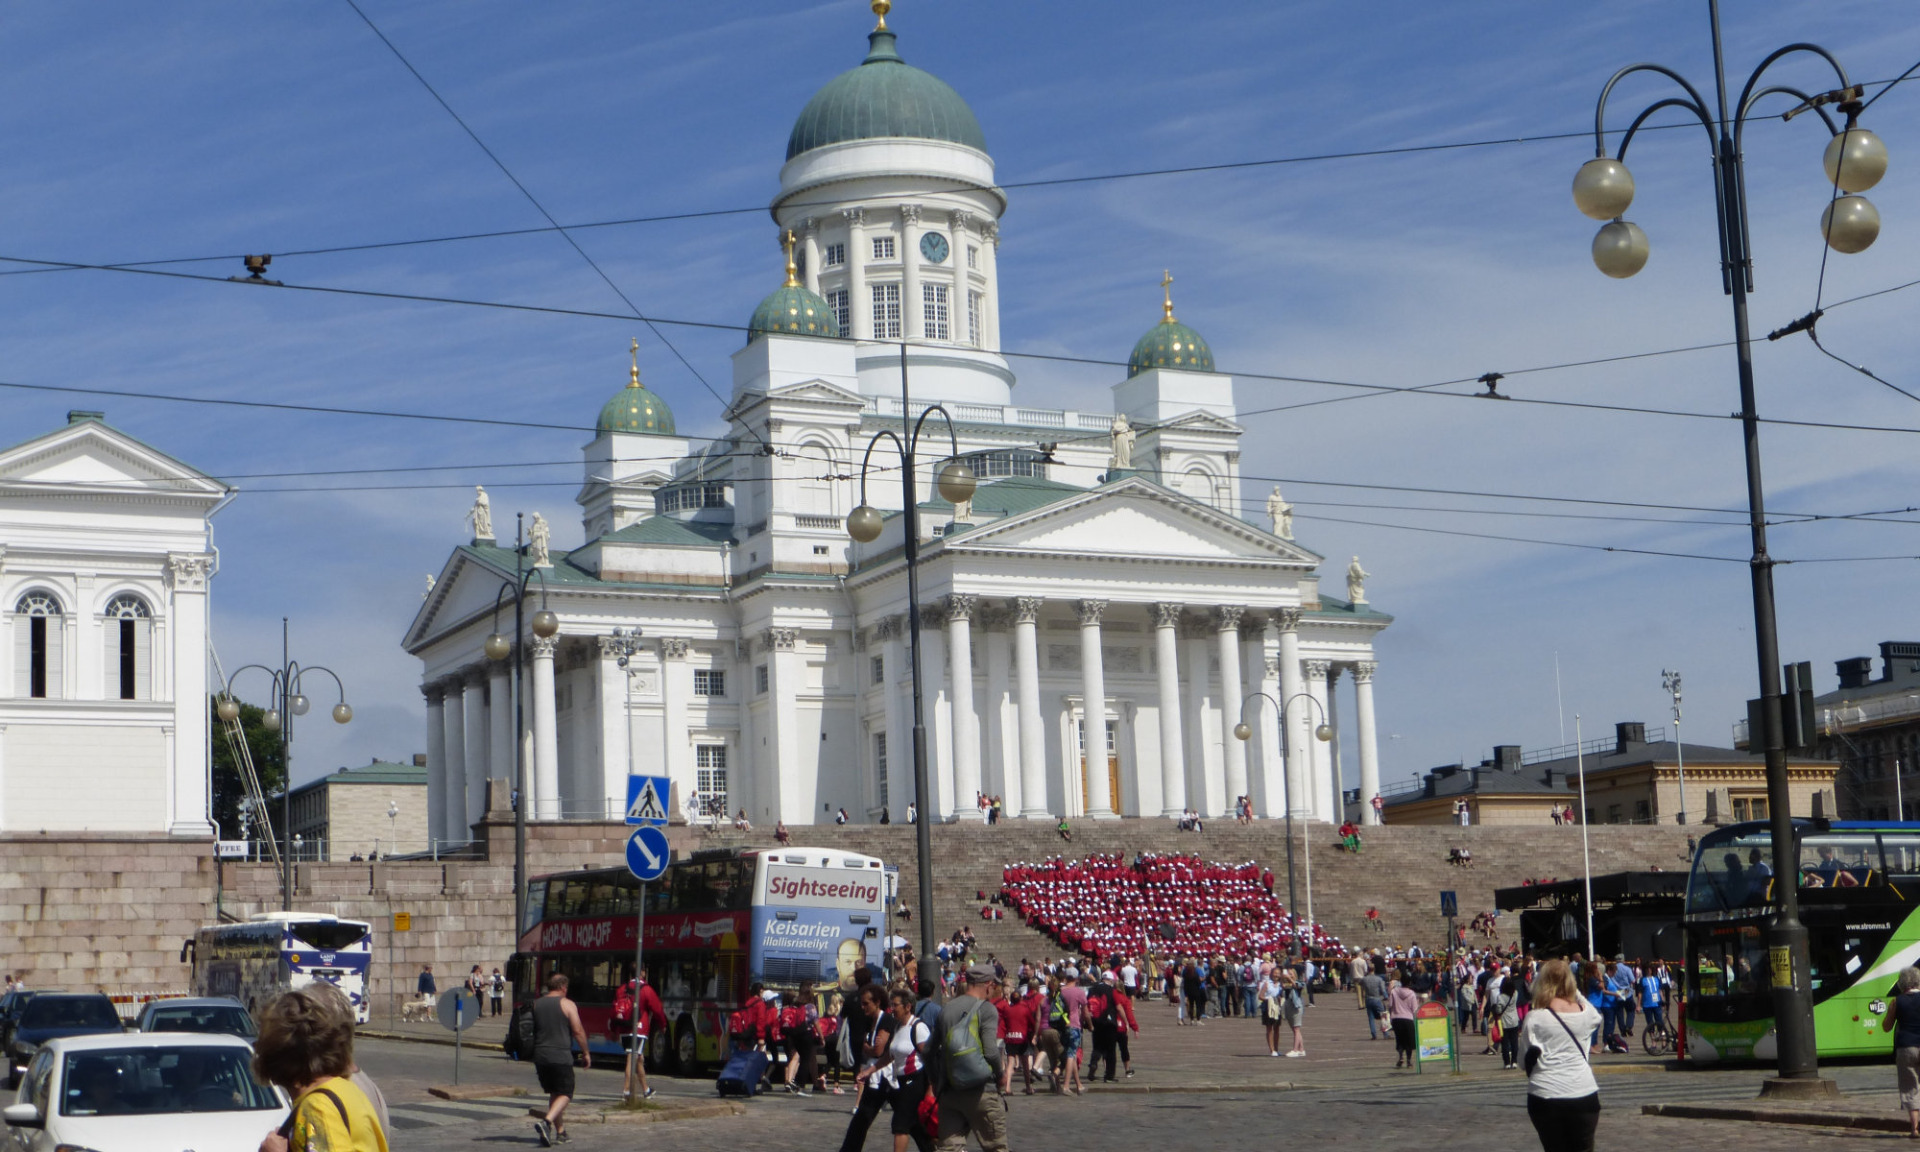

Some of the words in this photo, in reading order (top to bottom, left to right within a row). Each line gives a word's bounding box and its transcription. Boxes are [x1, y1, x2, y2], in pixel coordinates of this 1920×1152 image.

[770, 876, 879, 904] Sightseeing
[542, 922, 573, 949] HOP-ON
[576, 921, 612, 948] HOP-OFF
[764, 919, 841, 938] Keisarien
[762, 936, 829, 951] illallisristeilyt
